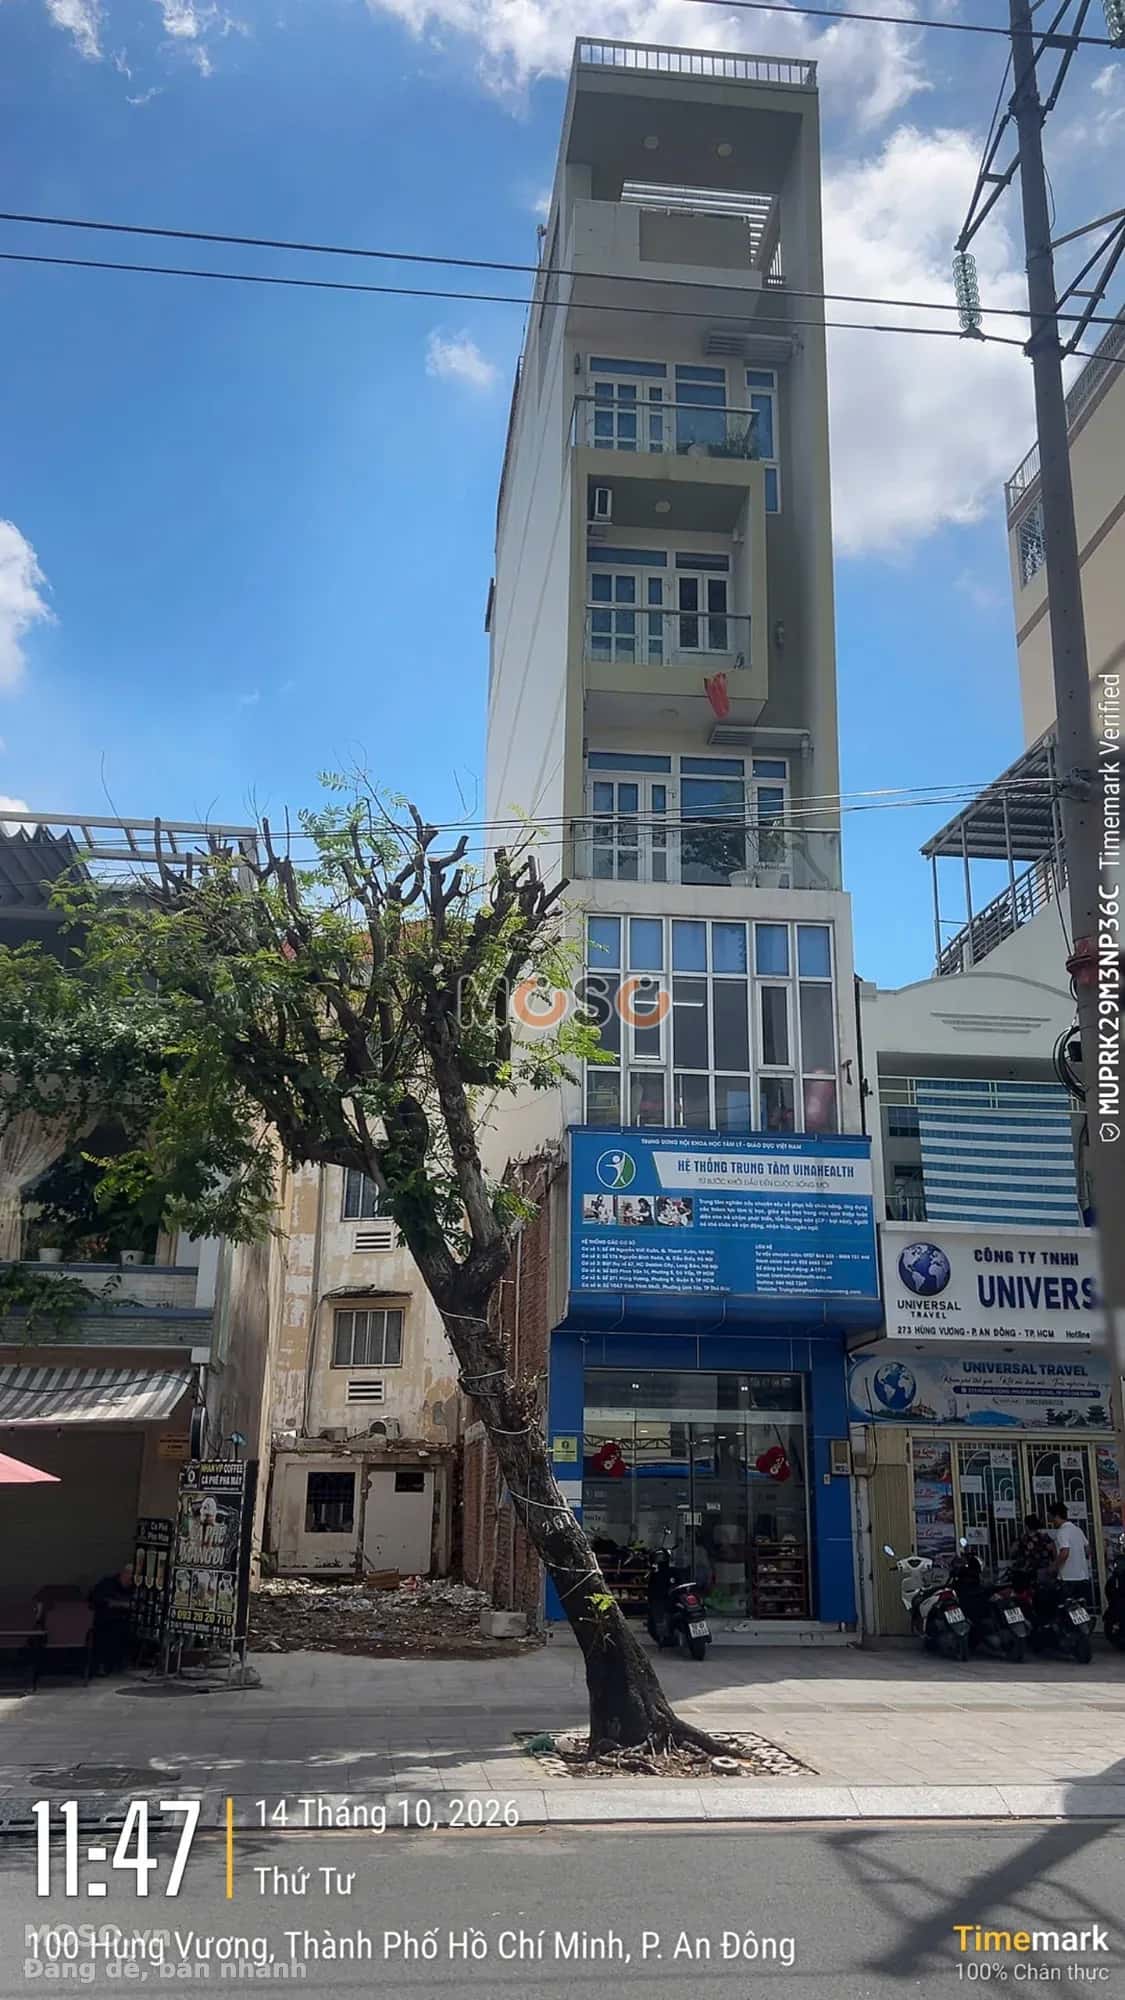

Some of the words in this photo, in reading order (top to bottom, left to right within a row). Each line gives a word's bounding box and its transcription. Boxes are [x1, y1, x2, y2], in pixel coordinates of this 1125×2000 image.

[693, 1156, 728, 1175] THỐNG
[731, 1160, 764, 1176] TRUNG
[793, 1162, 854, 1178] VINAHEALTH
[974, 1246, 1014, 1264] CÔNG
[1019, 1250, 1035, 1265] TY
[1040, 1250, 1080, 1267] TNHH
[897, 1299, 962, 1311] UNIVERSAL
[911, 1311, 948, 1320] TRAVEL
[897, 1326, 912, 1335] 273
[962, 1360, 1038, 1376] UNIVERSAL
[1041, 1363, 1089, 1377] TRAVEL
